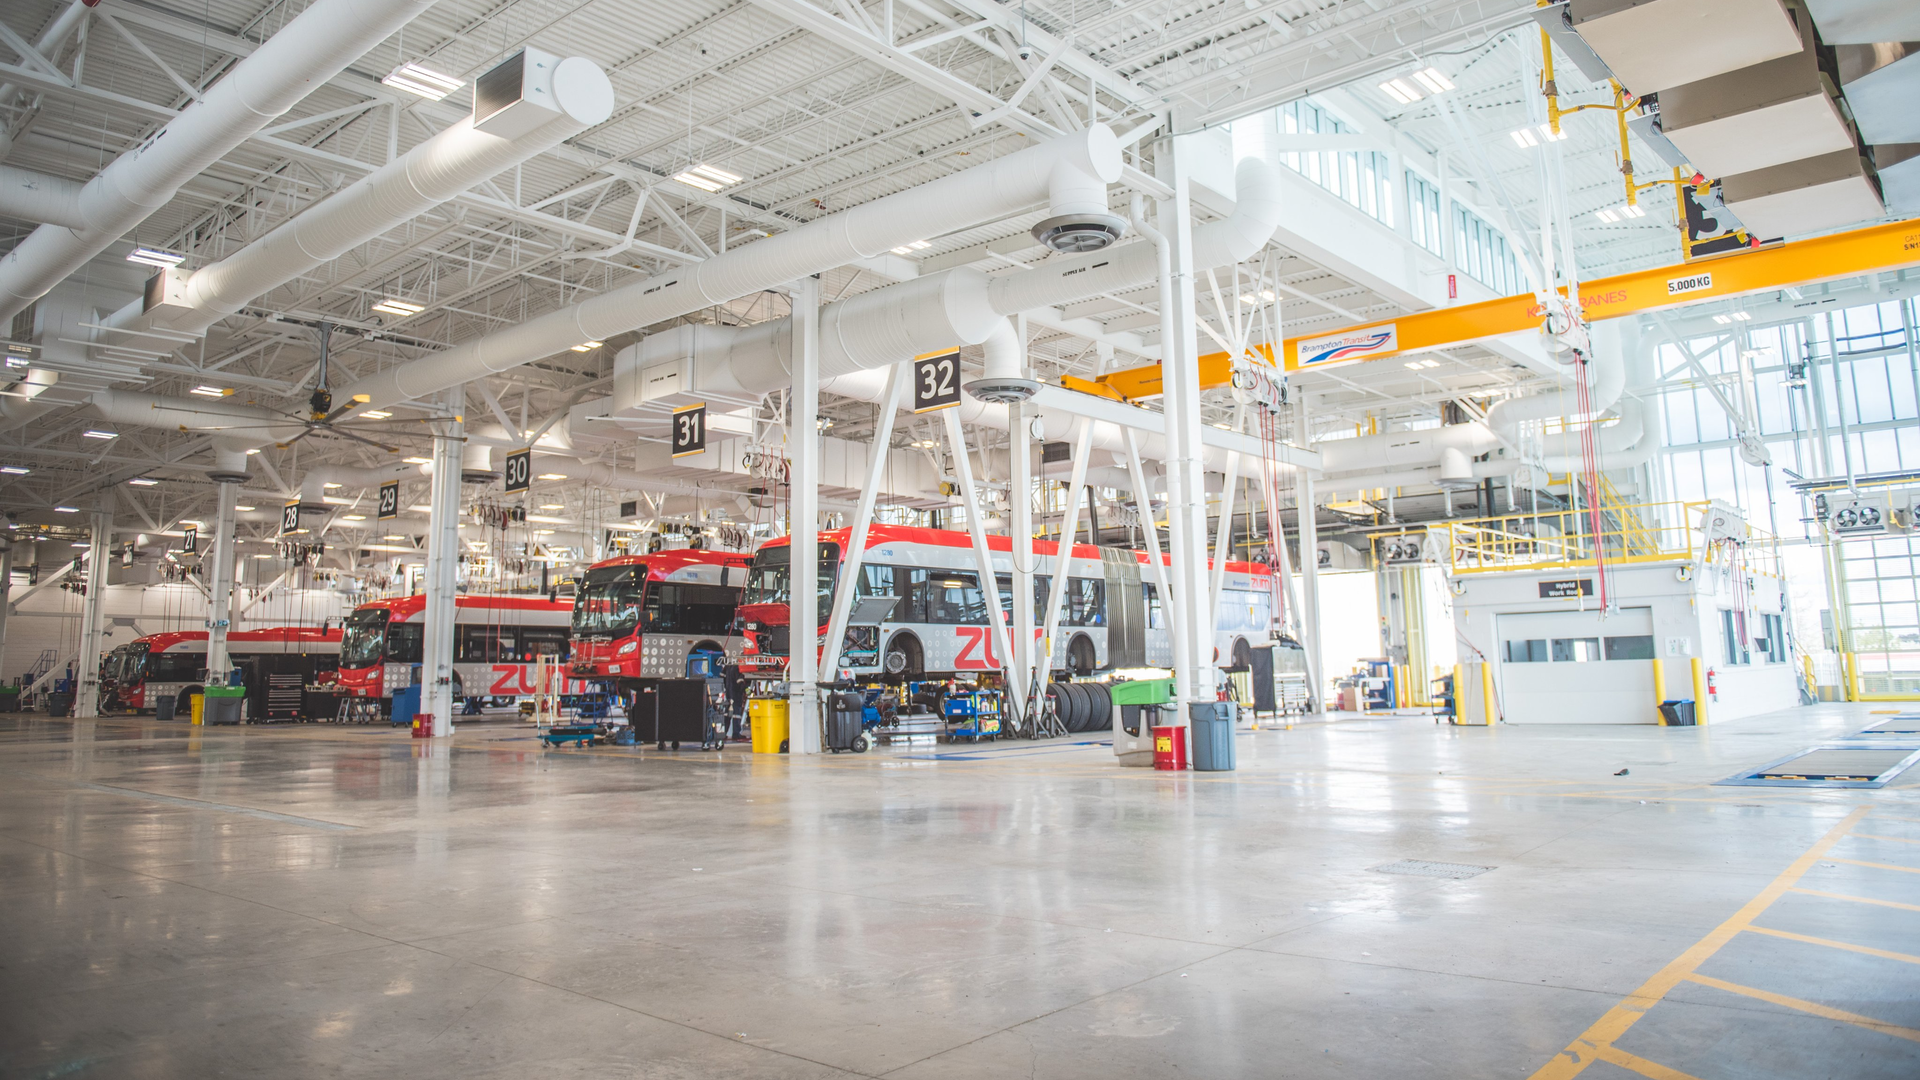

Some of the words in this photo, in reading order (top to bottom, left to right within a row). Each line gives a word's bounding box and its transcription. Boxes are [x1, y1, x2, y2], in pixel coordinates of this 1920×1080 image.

[1696, 276, 1710, 287] KG
[1301, 340, 1342, 354] Brampton
[1342, 334, 1371, 346] Transit
[920, 359, 954, 400] 32
[678, 412, 699, 447] 31
[507, 456, 528, 486] 30
[381, 487, 396, 513] 29
[284, 506, 298, 529] 28
[184, 530, 196, 550] 27
[122, 545, 133, 564] 26
